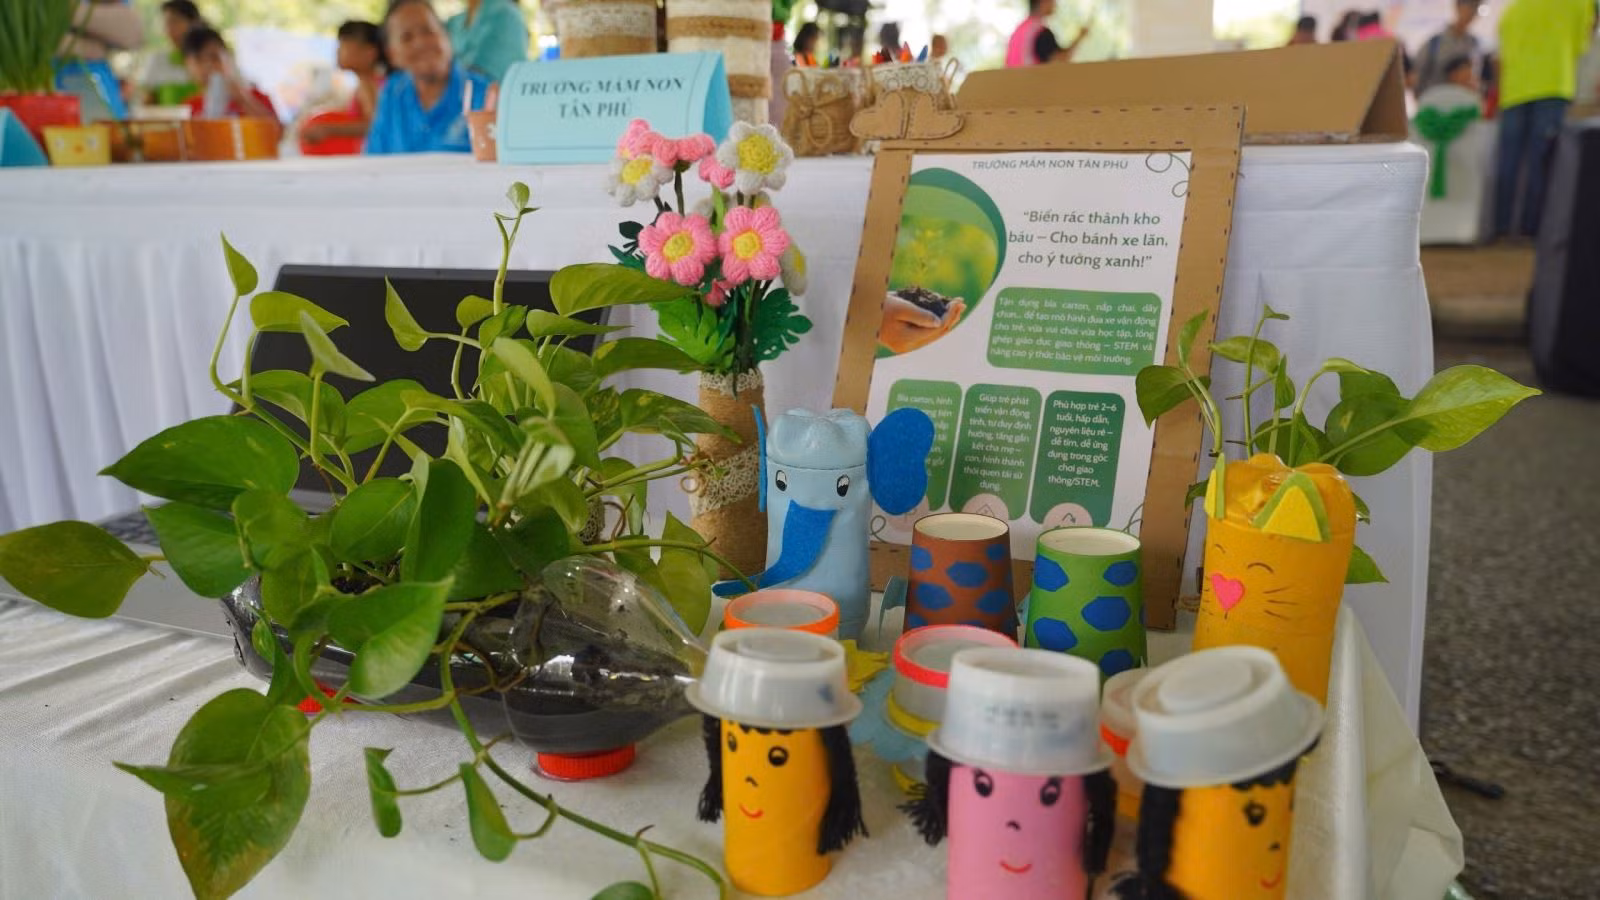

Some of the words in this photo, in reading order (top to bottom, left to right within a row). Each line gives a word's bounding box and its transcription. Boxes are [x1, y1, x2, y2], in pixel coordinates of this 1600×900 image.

[647, 76, 684, 92] NON
[1049, 159, 1074, 169] NON
[1063, 210, 1085, 223] rác
[1088, 211, 1129, 225] thành
[1133, 212, 1161, 225] kho
[1008, 231, 1034, 243] báu
[1050, 231, 1078, 244] Cho
[1082, 232, 1118, 246] bánh
[1121, 236, 1139, 246] xe
[1018, 251, 1043, 264] cho
[1046, 251, 1055, 267] ý
[1059, 252, 1101, 270] tưởng
[1113, 341, 1139, 351] STEM
[1070, 451, 1092, 463] trong
[1076, 465, 1094, 475] giao
